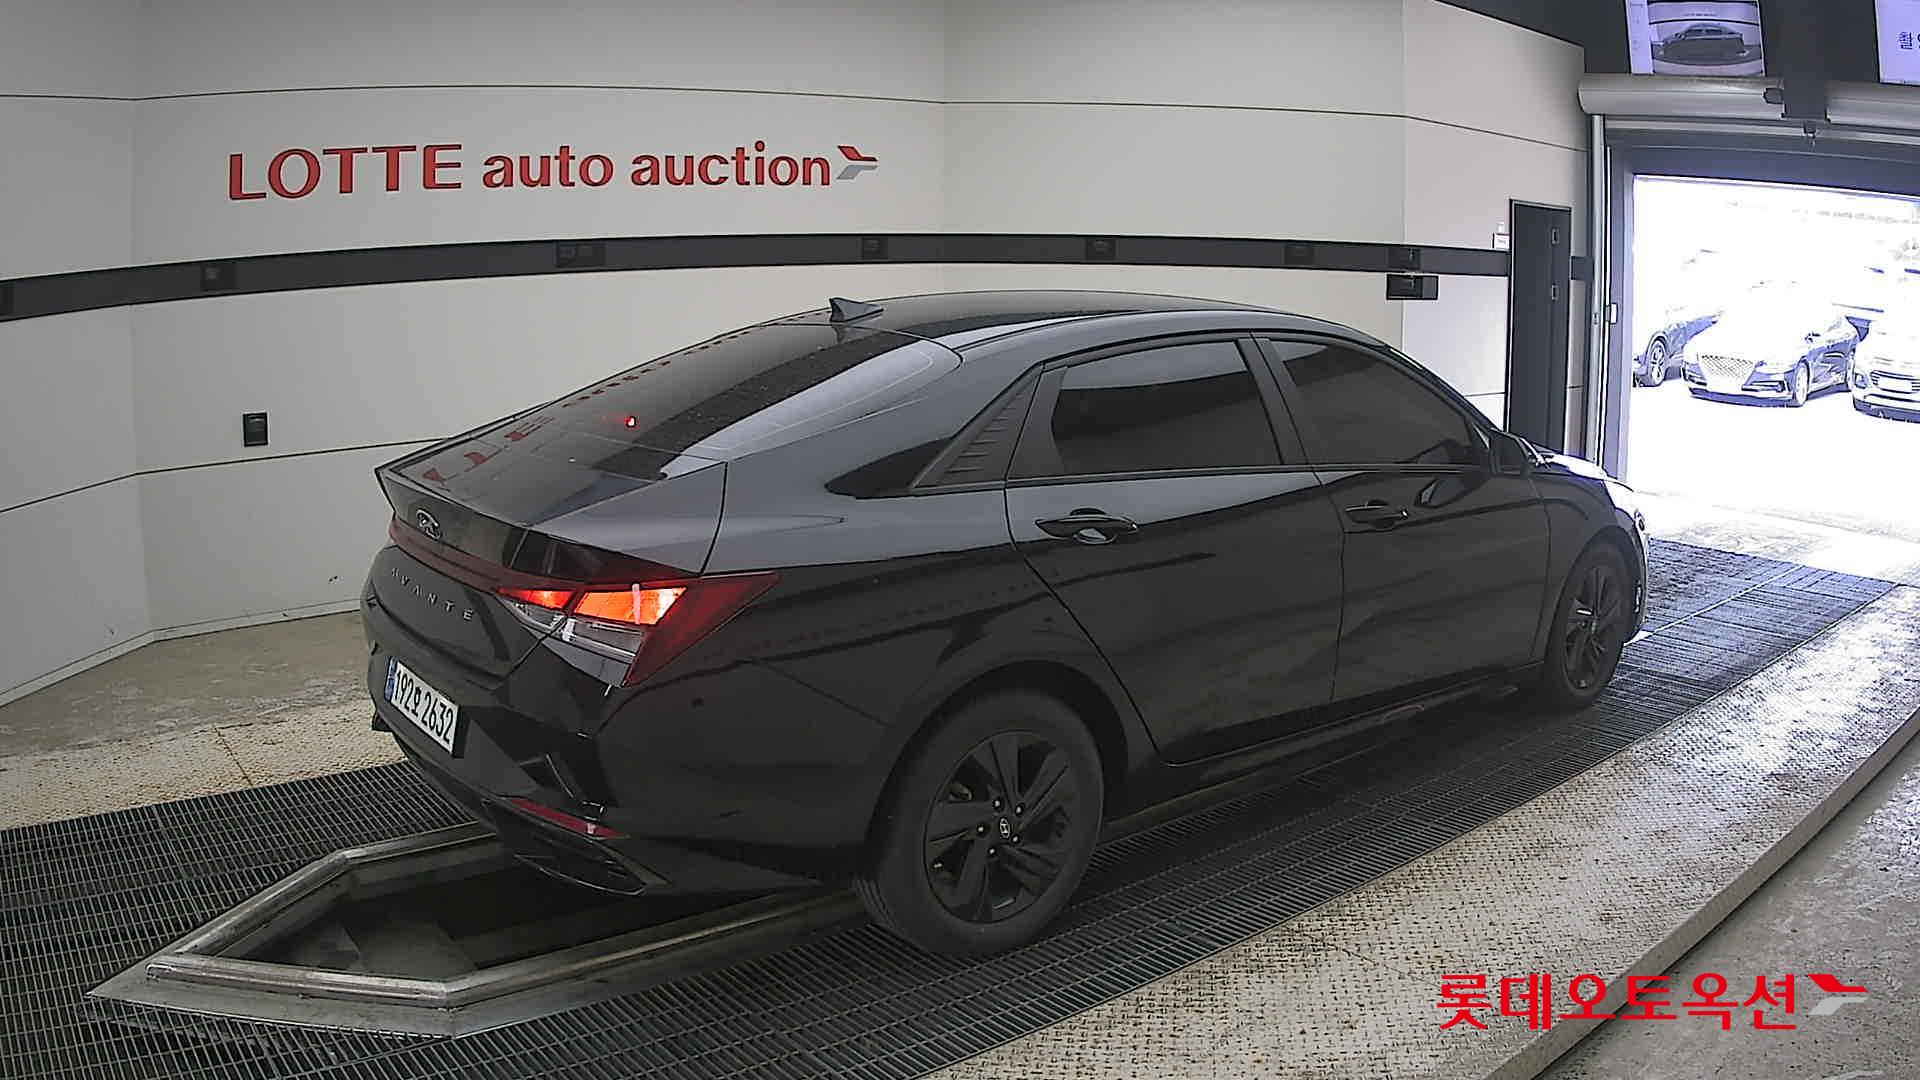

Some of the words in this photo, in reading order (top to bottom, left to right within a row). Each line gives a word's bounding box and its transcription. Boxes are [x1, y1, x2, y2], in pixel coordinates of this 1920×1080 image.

[229, 144, 462, 200] LOTTE
[482, 146, 614, 189] auto
[631, 141, 831, 187] auction
[391, 567, 473, 621] AVANTE
[421, 691, 453, 744] 2632
